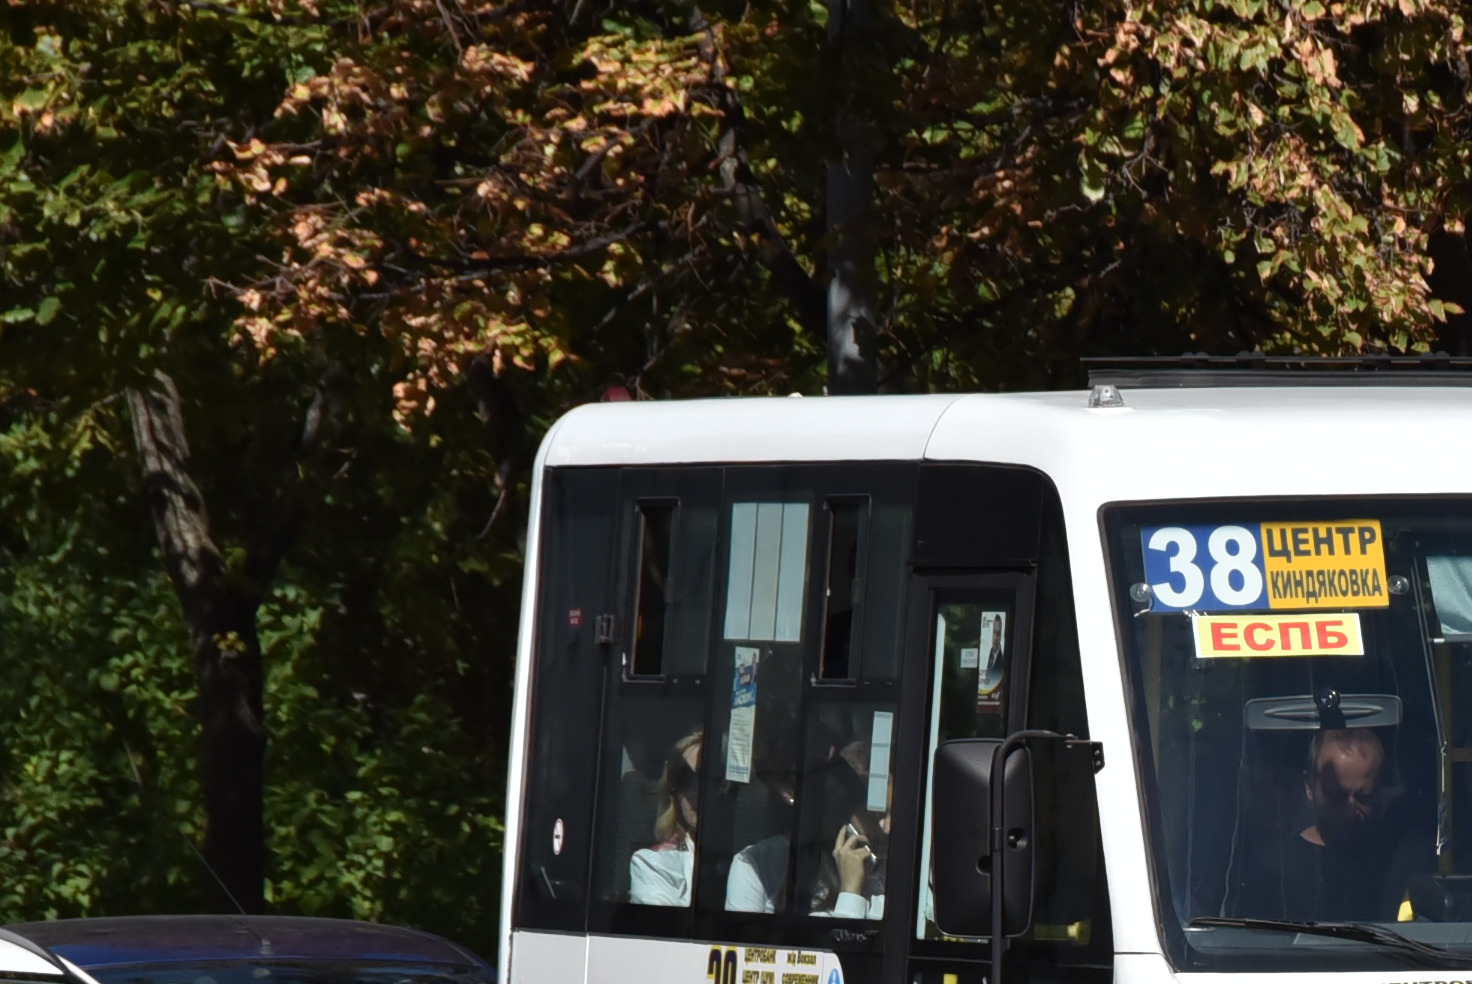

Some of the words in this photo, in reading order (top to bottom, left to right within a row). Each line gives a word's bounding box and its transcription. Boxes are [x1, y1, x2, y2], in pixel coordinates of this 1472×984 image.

[1266, 526, 1376, 563] ЦЕНТР
[1148, 525, 1263, 608] 38
[1270, 568, 1383, 603] КИНДЯКОВКА
[1210, 620, 1348, 651] ЕСПБ
